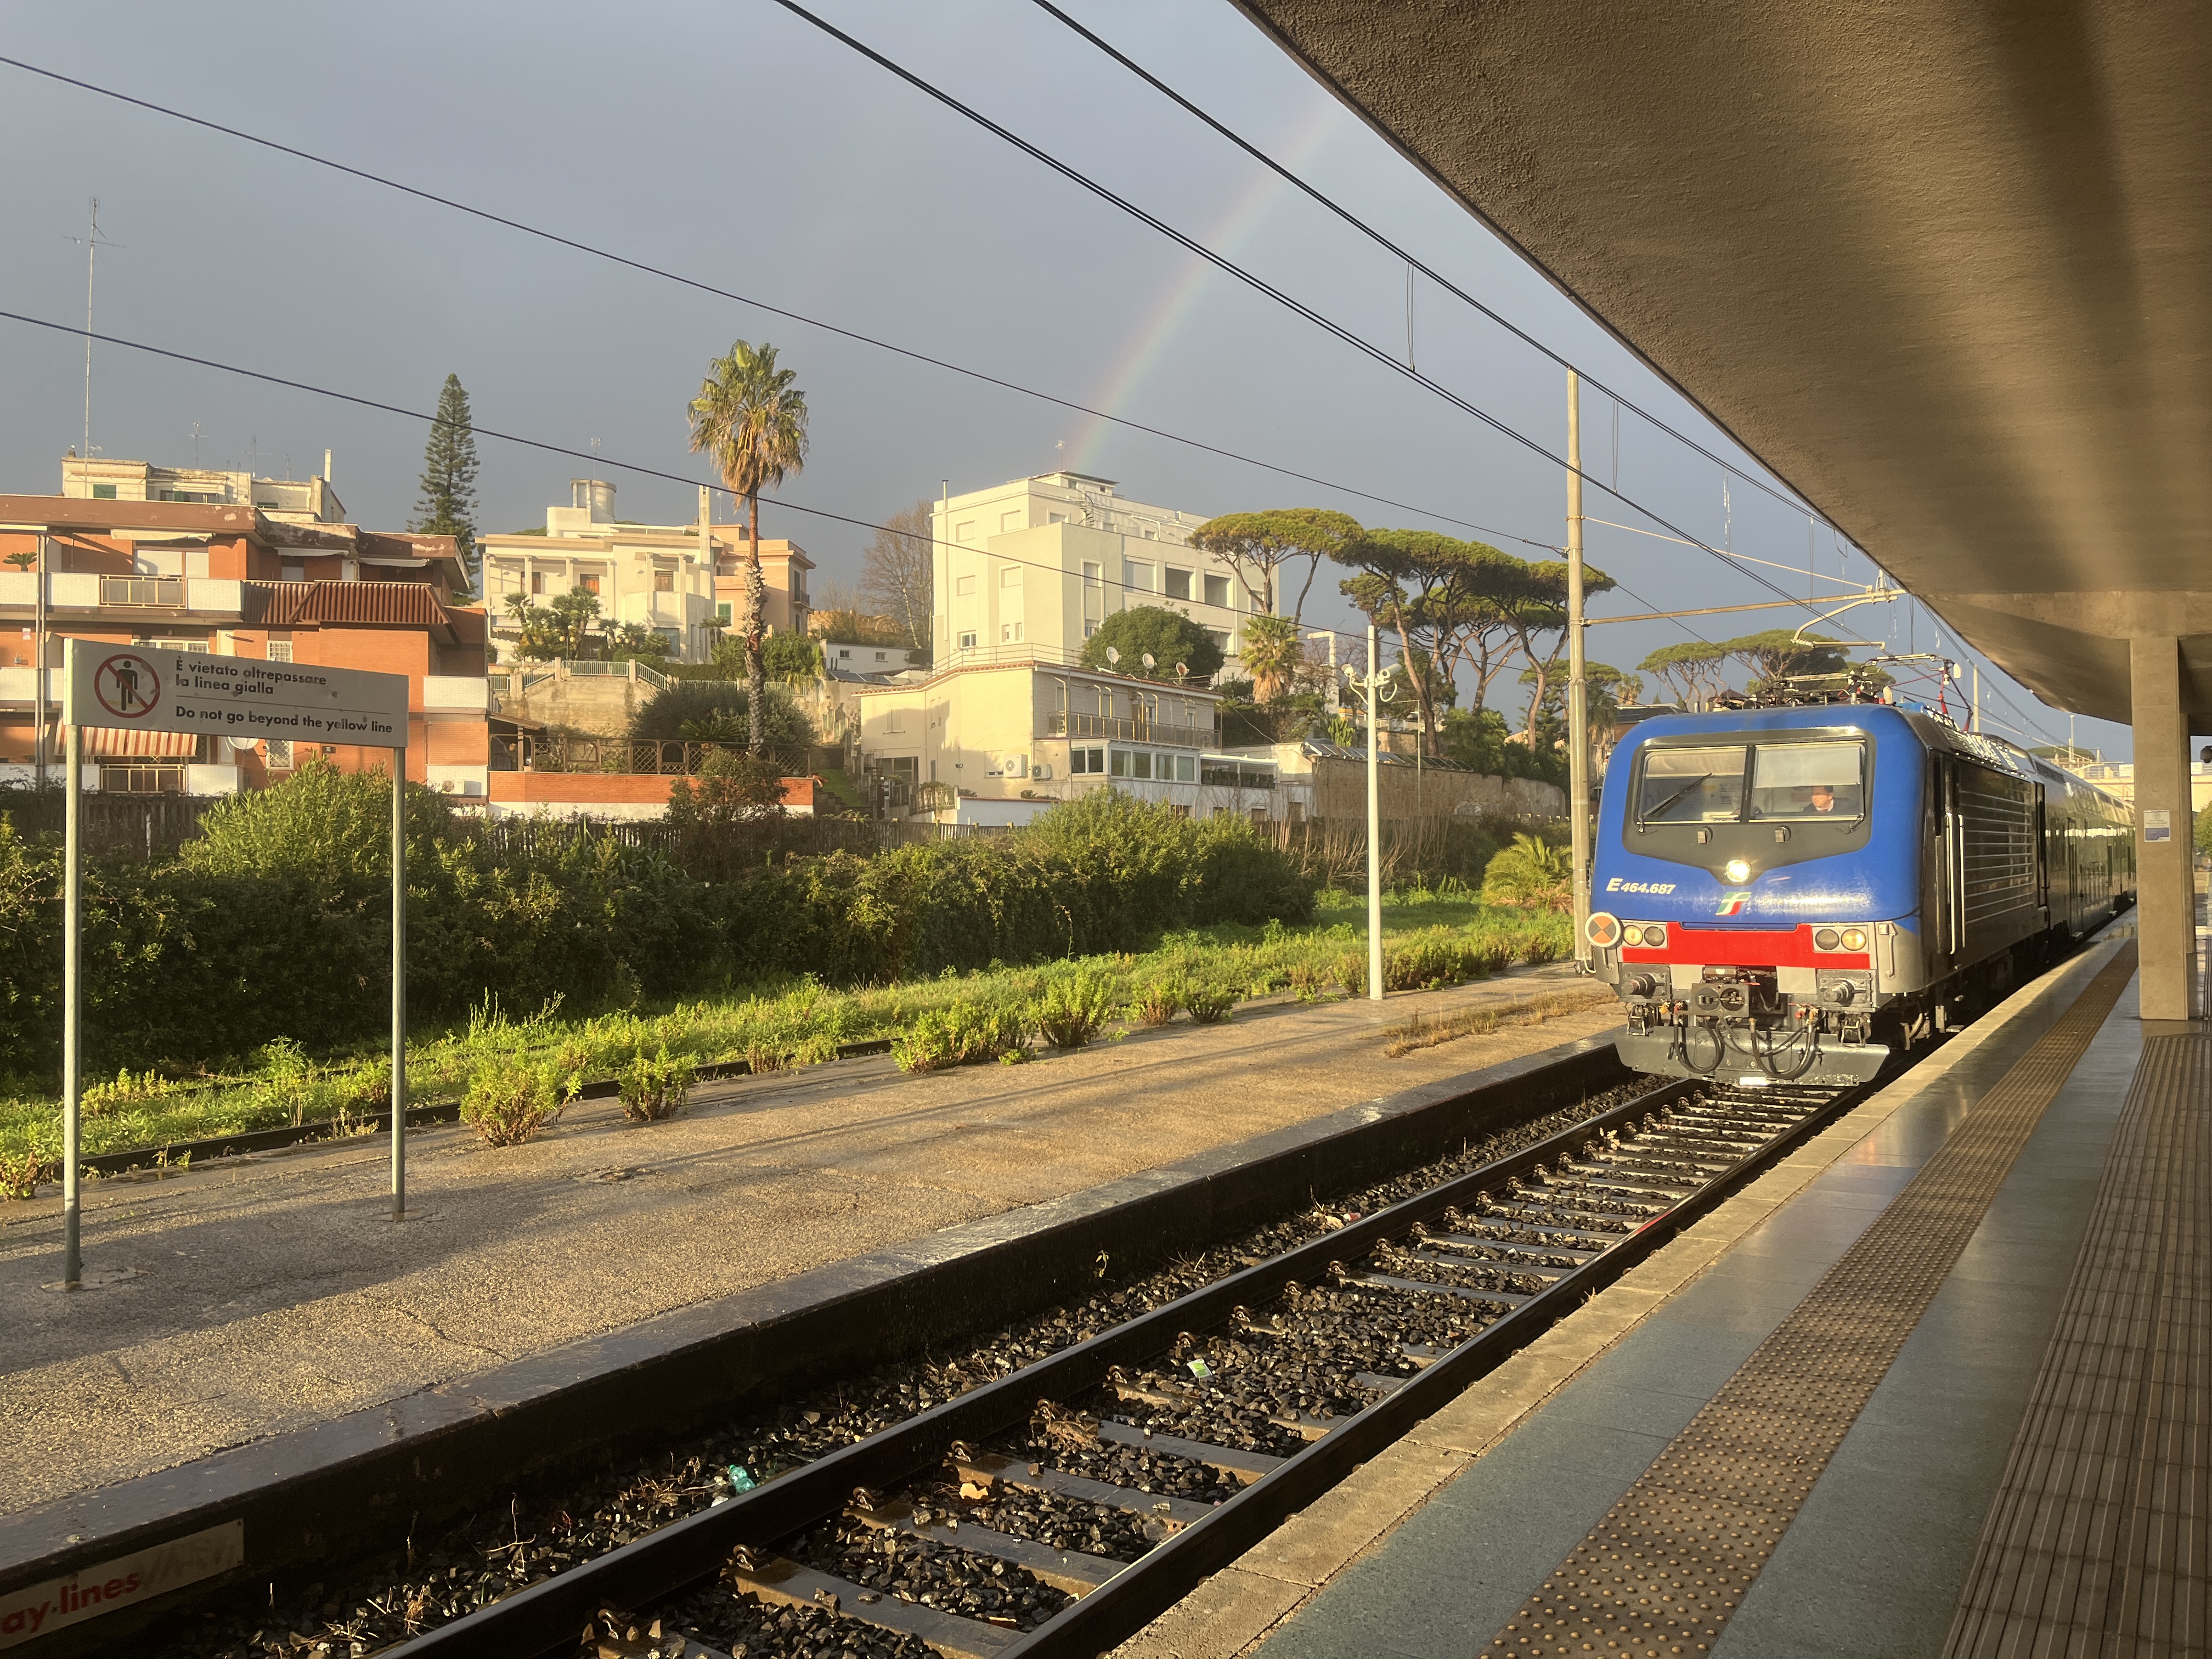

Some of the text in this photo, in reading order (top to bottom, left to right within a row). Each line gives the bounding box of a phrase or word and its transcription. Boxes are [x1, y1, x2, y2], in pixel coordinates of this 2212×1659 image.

[176, 674, 274, 695] la linea gialla
[188, 662, 239, 676] vietato
[243, 667, 327, 685] oltrepassare
[176, 706, 393, 733] Do not go beyond the yellow line
[0, 1571, 139, 1634] ay lines
